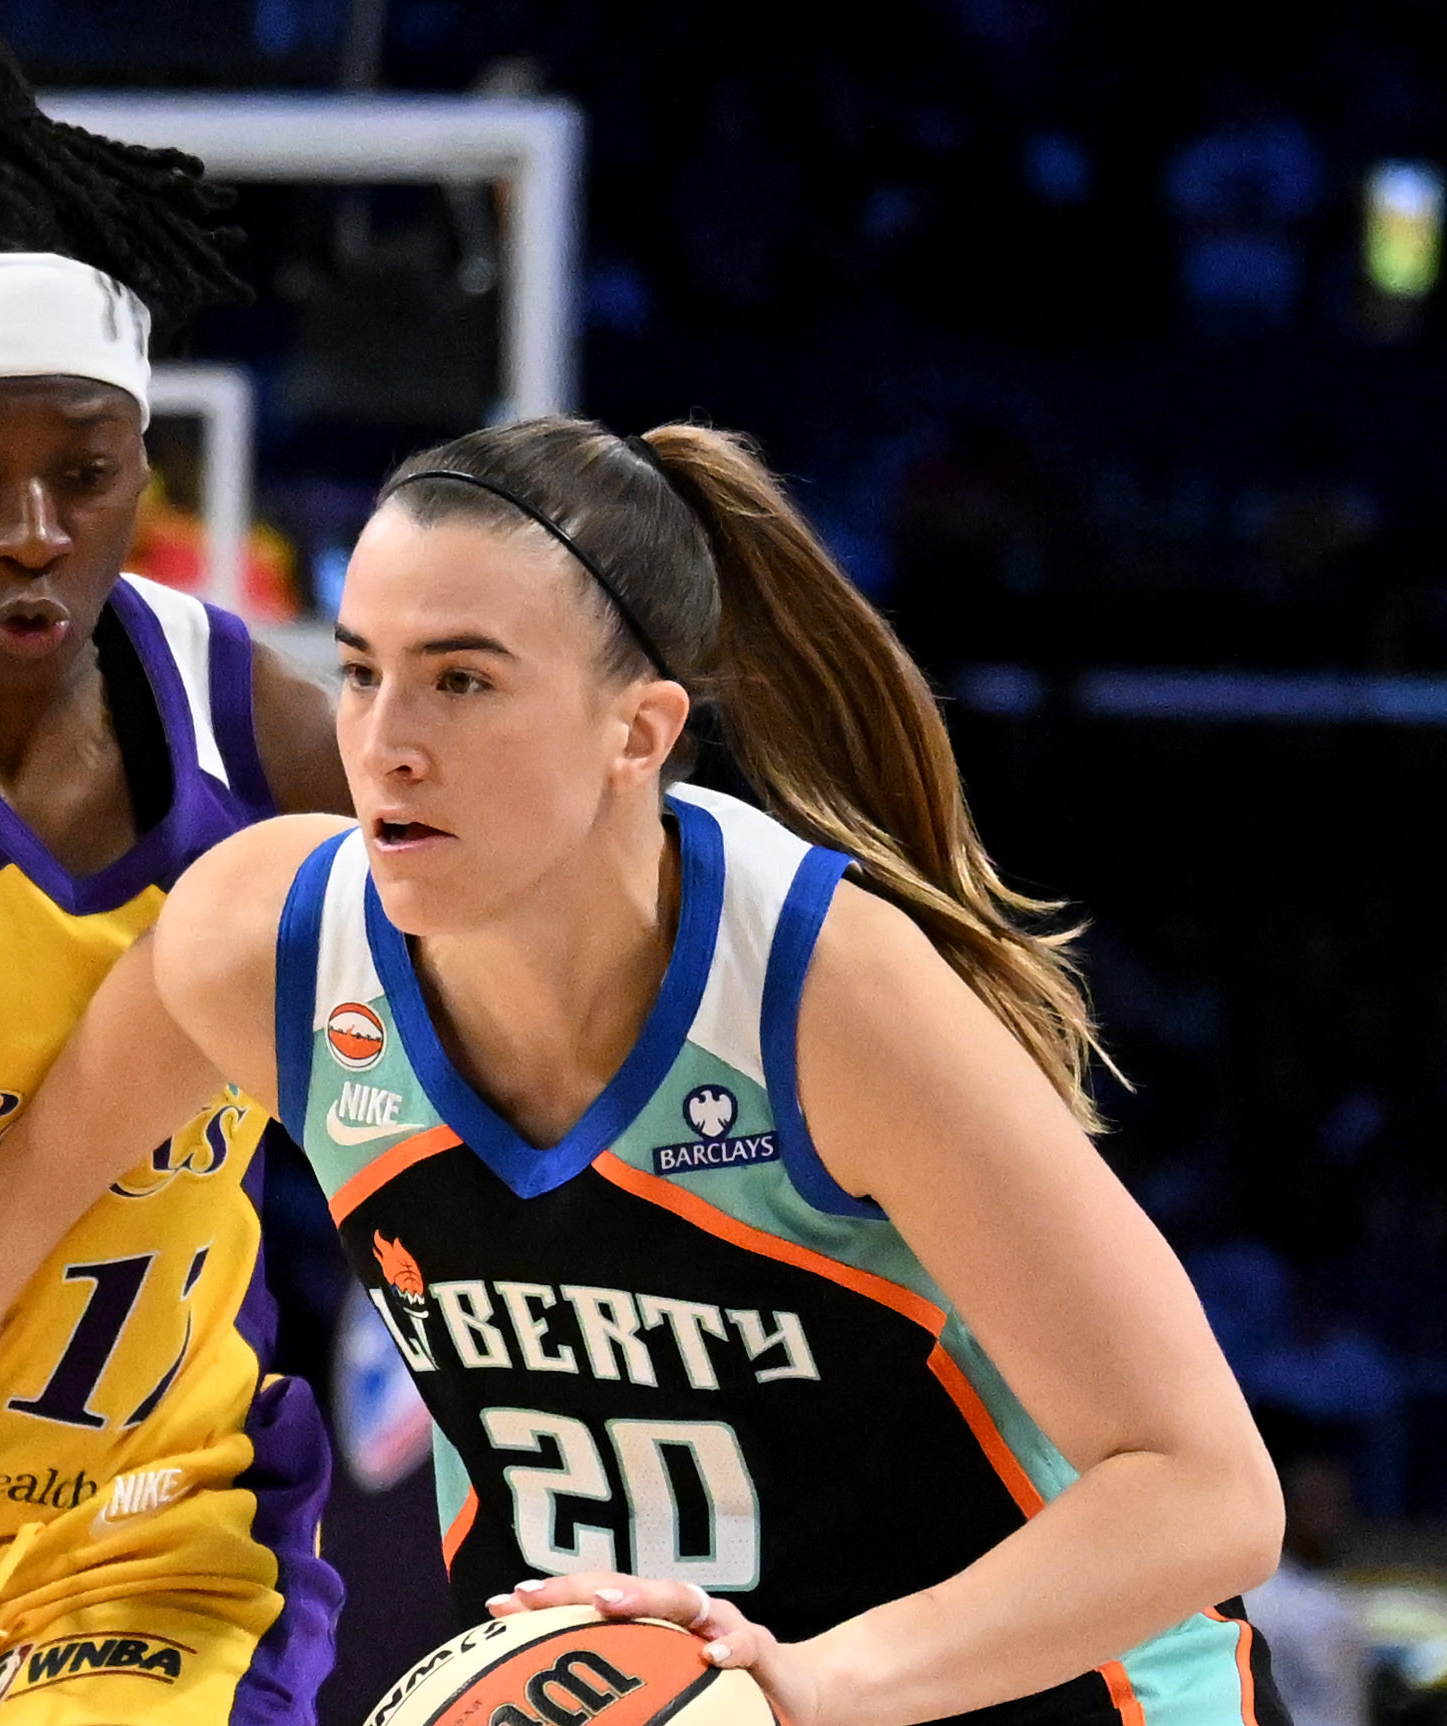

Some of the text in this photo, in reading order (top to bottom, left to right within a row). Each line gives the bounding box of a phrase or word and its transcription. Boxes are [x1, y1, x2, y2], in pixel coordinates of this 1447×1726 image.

[339, 1081, 403, 1125] NIKE
[660, 1134, 774, 1170] BARCLAYS
[110, 1468, 183, 1517] NIKE
[480, 1407, 760, 1592] 20
[27, 1639, 184, 1684] WNBA
